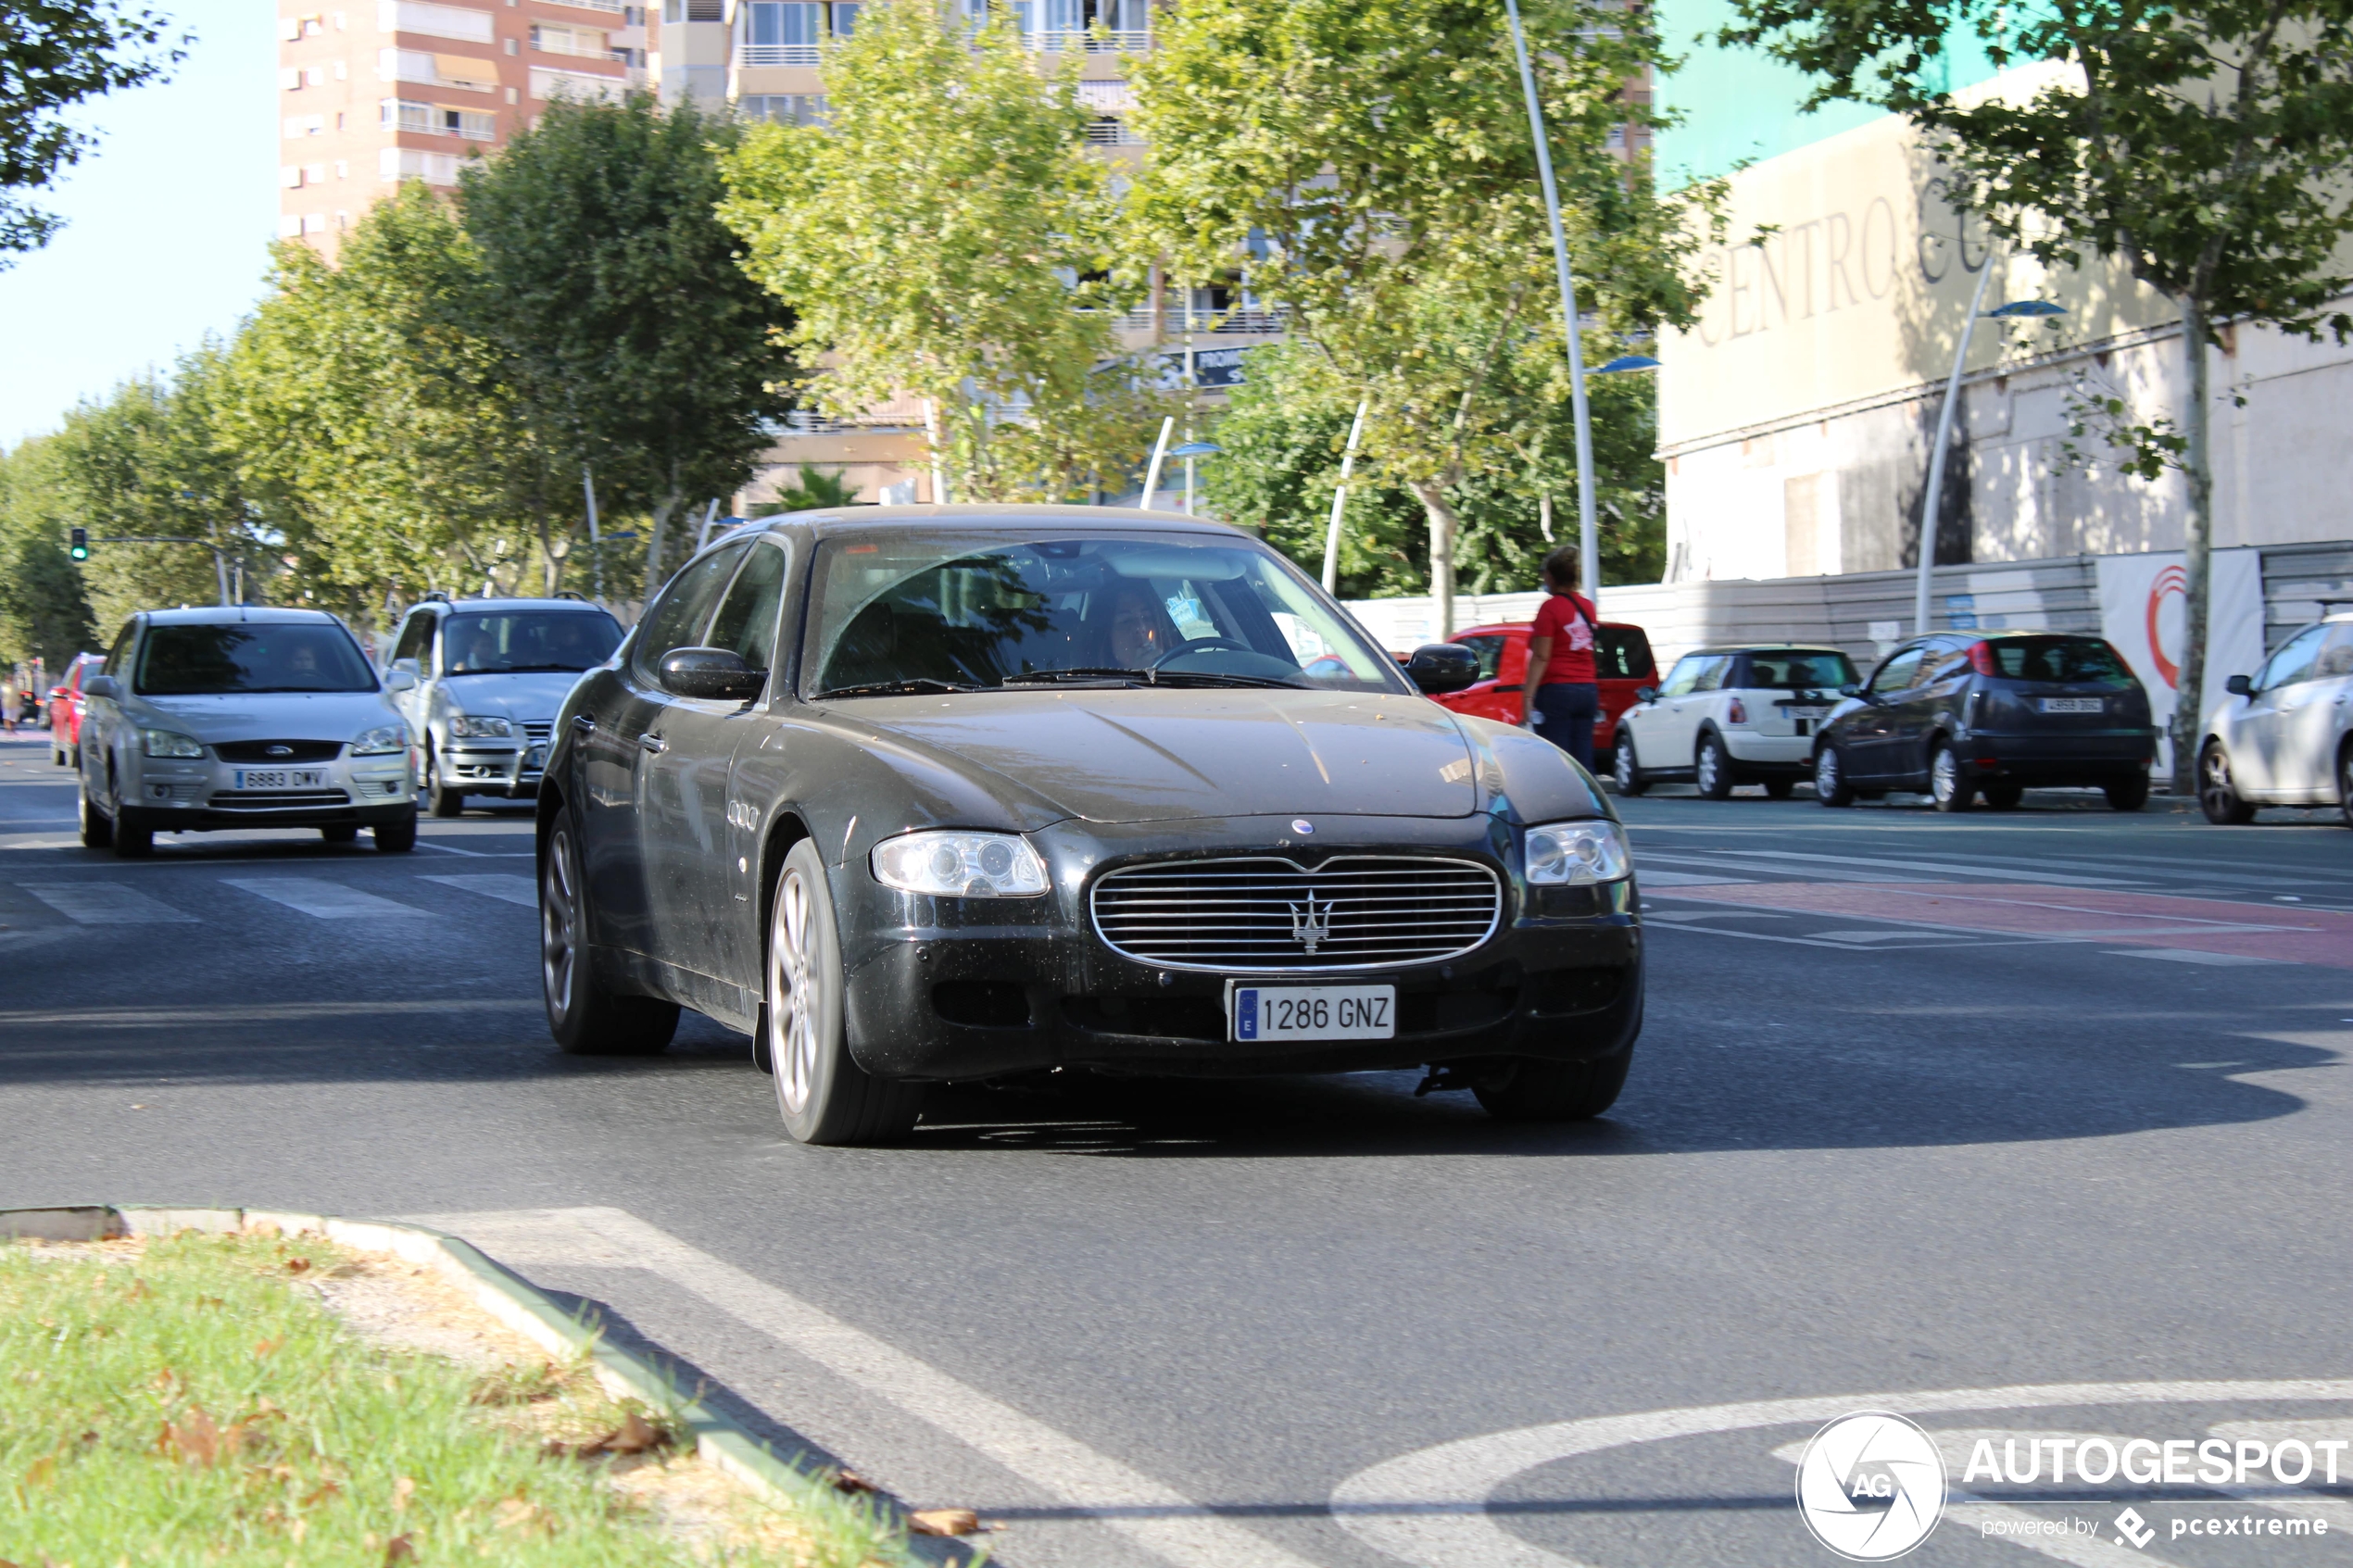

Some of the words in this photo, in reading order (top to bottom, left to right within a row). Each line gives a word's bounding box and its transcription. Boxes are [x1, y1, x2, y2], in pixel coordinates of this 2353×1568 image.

[1698, 195, 1897, 348] CENTRO
[246, 771, 285, 787] 6883
[1243, 1020, 1252, 1031] E
[1265, 999, 1328, 1030] 1286
[1339, 997, 1389, 1028] GNZ
